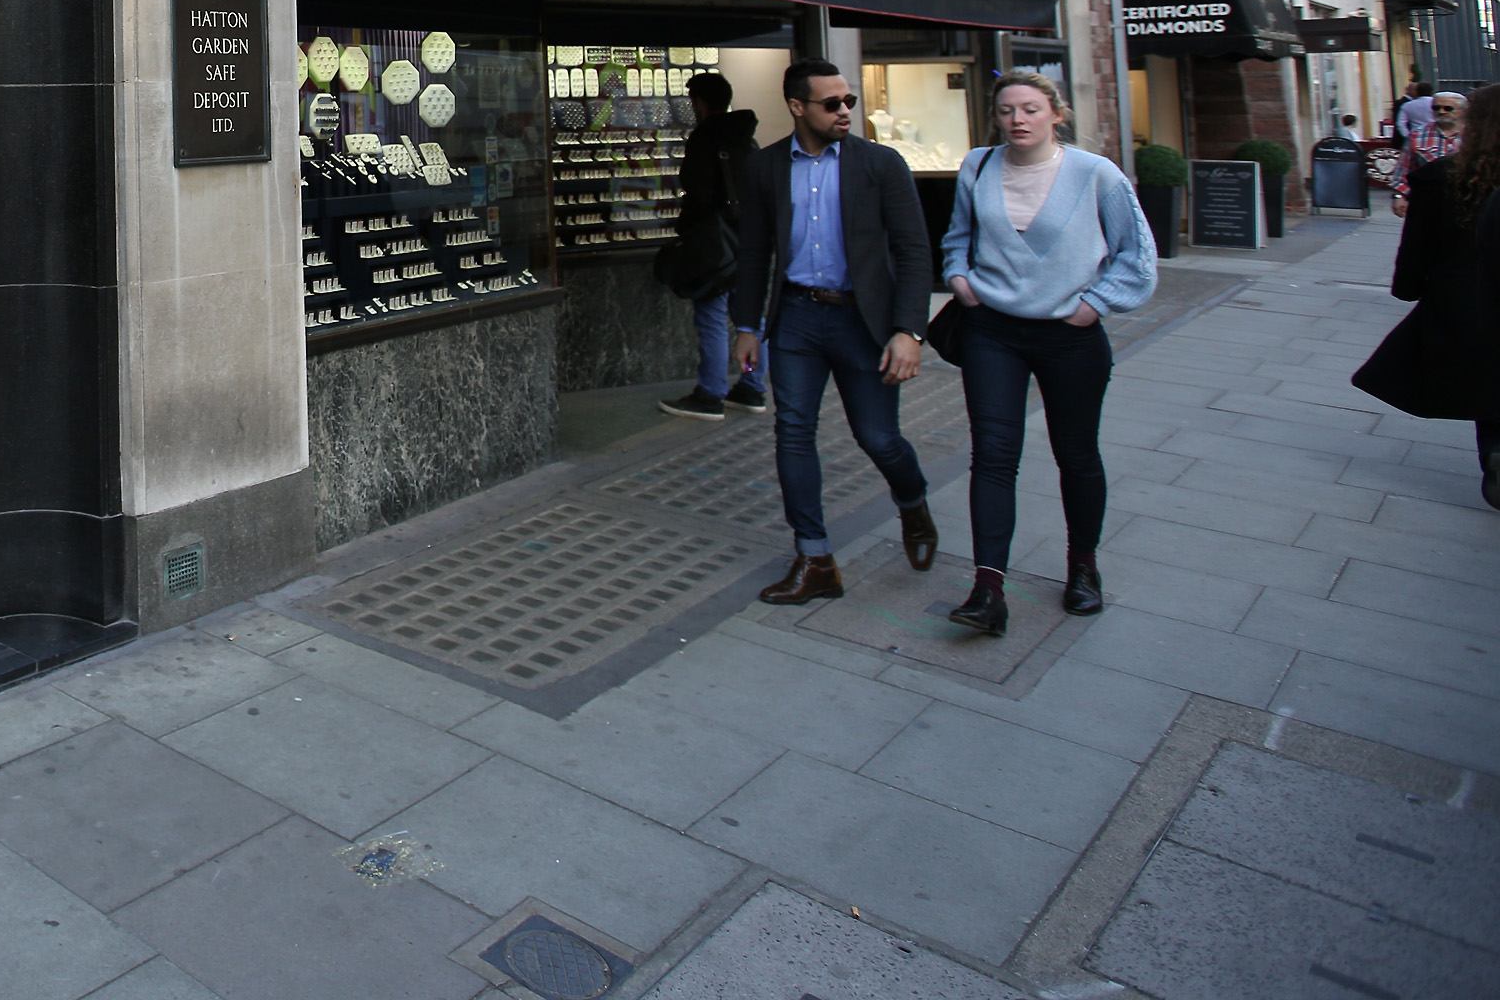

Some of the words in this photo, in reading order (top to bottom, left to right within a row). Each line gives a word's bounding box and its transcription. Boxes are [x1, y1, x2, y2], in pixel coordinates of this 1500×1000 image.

[191, 10, 248, 28] HATTON
[1126, 19, 1227, 36] DIAMONDS
[192, 37, 249, 55] GARDEN
[206, 64, 236, 81] SAFE
[193, 91, 250, 109] DEPOSIT
[212, 118, 235, 133] LTD.
